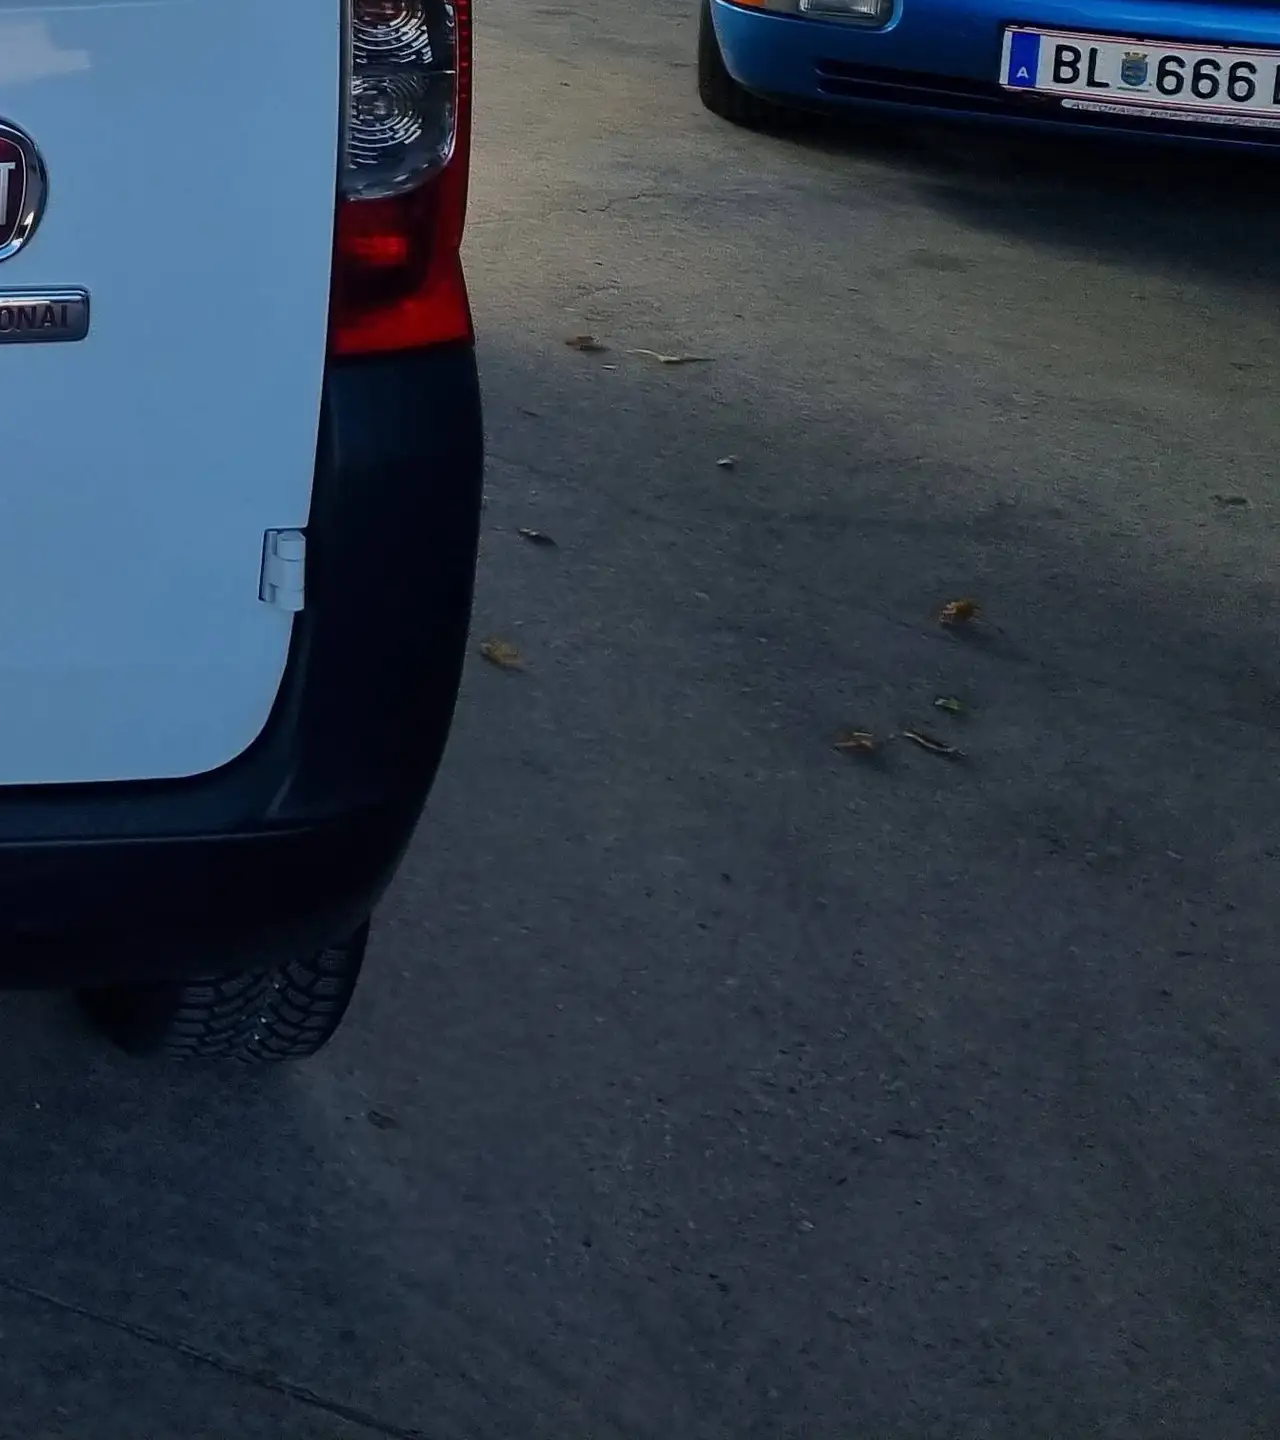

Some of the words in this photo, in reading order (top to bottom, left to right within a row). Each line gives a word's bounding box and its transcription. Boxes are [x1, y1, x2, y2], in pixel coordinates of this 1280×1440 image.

[1016, 67, 1029, 79] A
[1052, 43, 1110, 88] BL
[1156, 55, 1258, 102] 666
